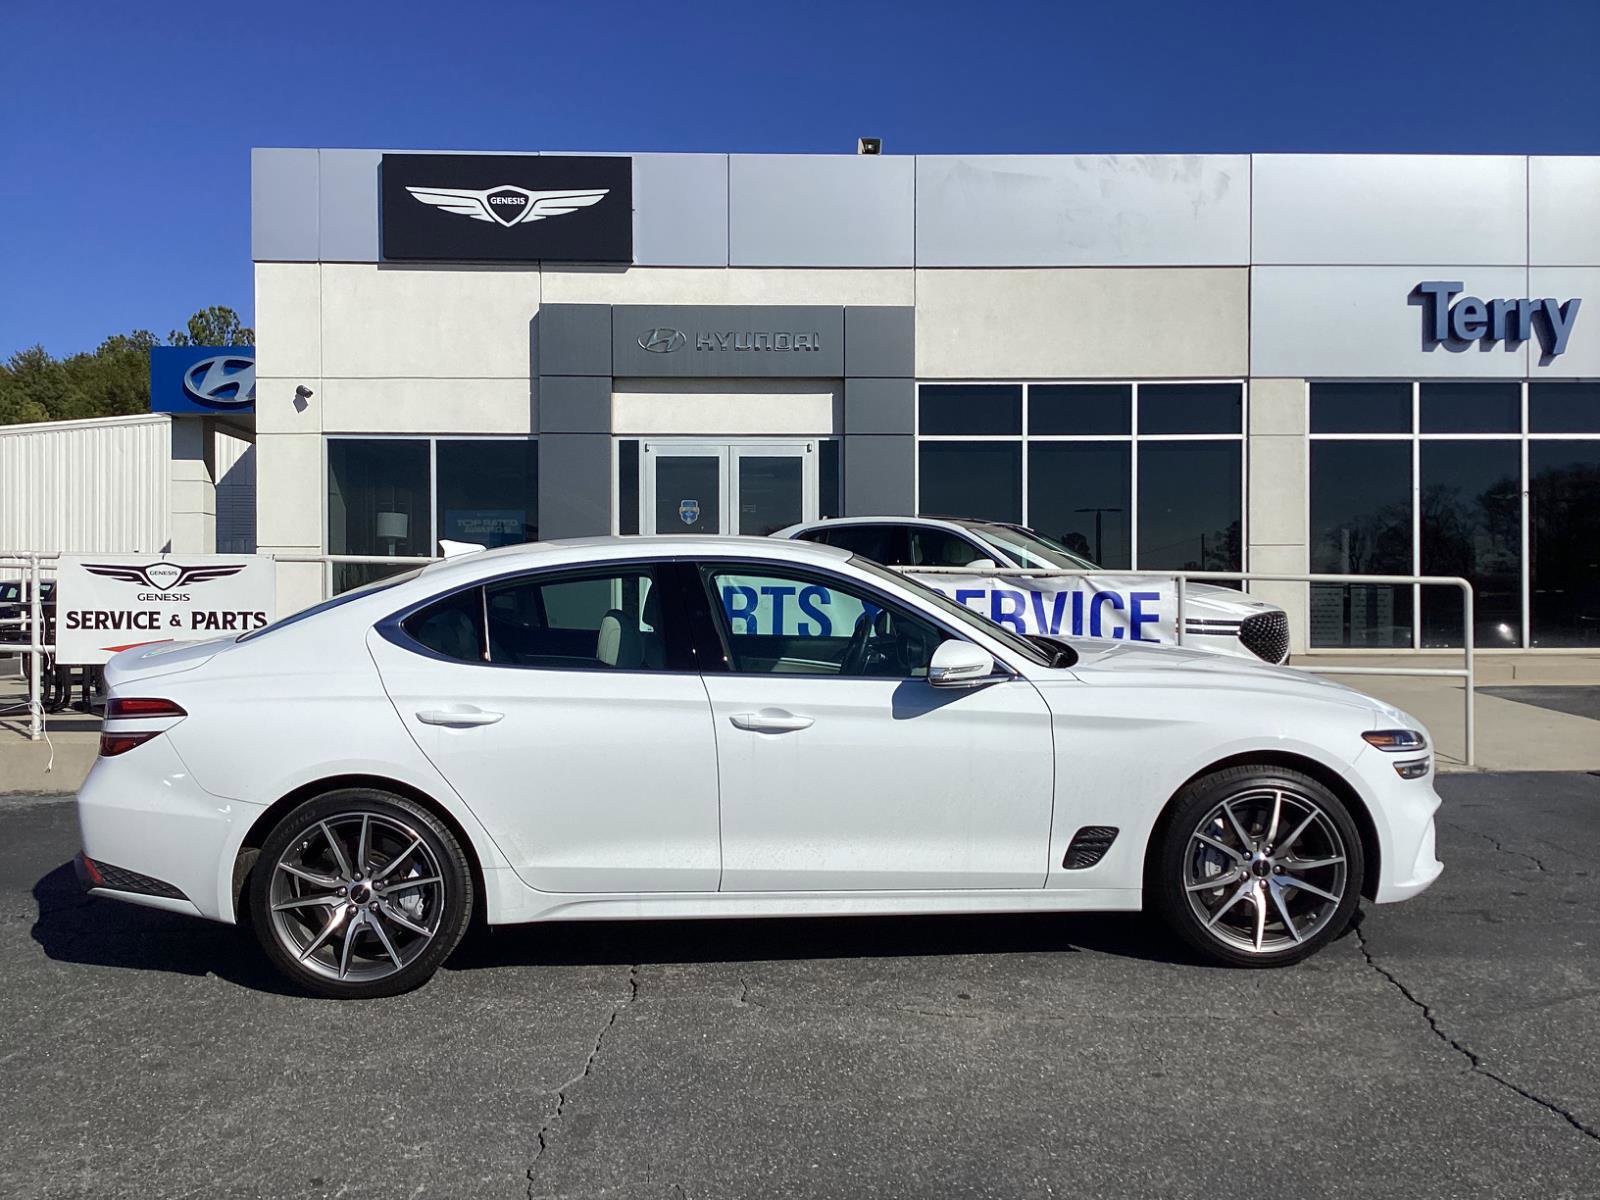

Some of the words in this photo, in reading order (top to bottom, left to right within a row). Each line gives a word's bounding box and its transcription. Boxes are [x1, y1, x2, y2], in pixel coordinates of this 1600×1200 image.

[1420, 281, 1582, 355] Terry
[696, 331, 820, 351] HYUNDAI
[136, 593, 191, 602] GENESIS
[66, 611, 161, 630] SERVICE
[169, 614, 182, 627] &
[191, 611, 268, 630] PARTS
[722, 586, 833, 637] RTS
